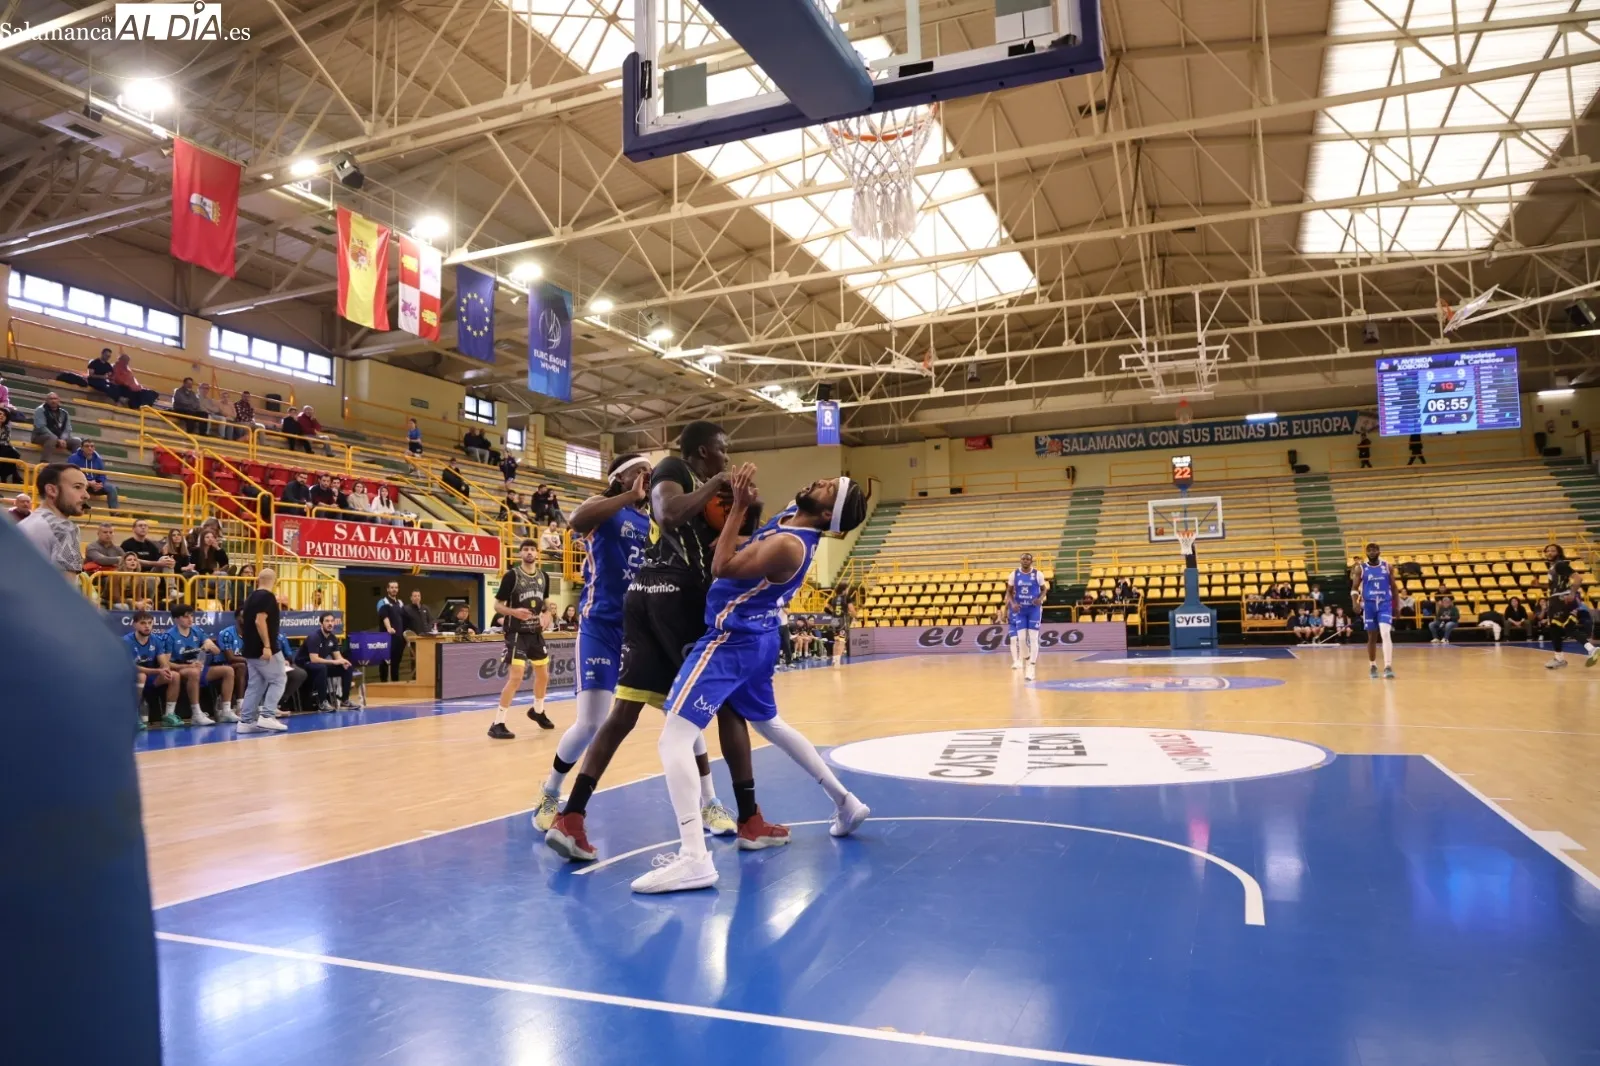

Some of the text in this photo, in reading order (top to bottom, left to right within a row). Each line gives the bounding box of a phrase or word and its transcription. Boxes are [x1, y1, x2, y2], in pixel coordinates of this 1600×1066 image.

[1427, 398, 1469, 412] 06:55
[824, 410, 833, 426] 8
[1461, 413, 1467, 422] 3
[1062, 416, 1351, 453] SALAMANCA CON SUS REINAS DE EUROPA
[1174, 467, 1191, 479] 22
[334, 523, 481, 552] SALAMANCA
[305, 540, 497, 567] PATRIMONIO DE LA HUMANIDAD
[835, 606, 842, 616] 5
[918, 626, 1084, 650] El Gso
[928, 730, 1006, 778] CASTILLA
